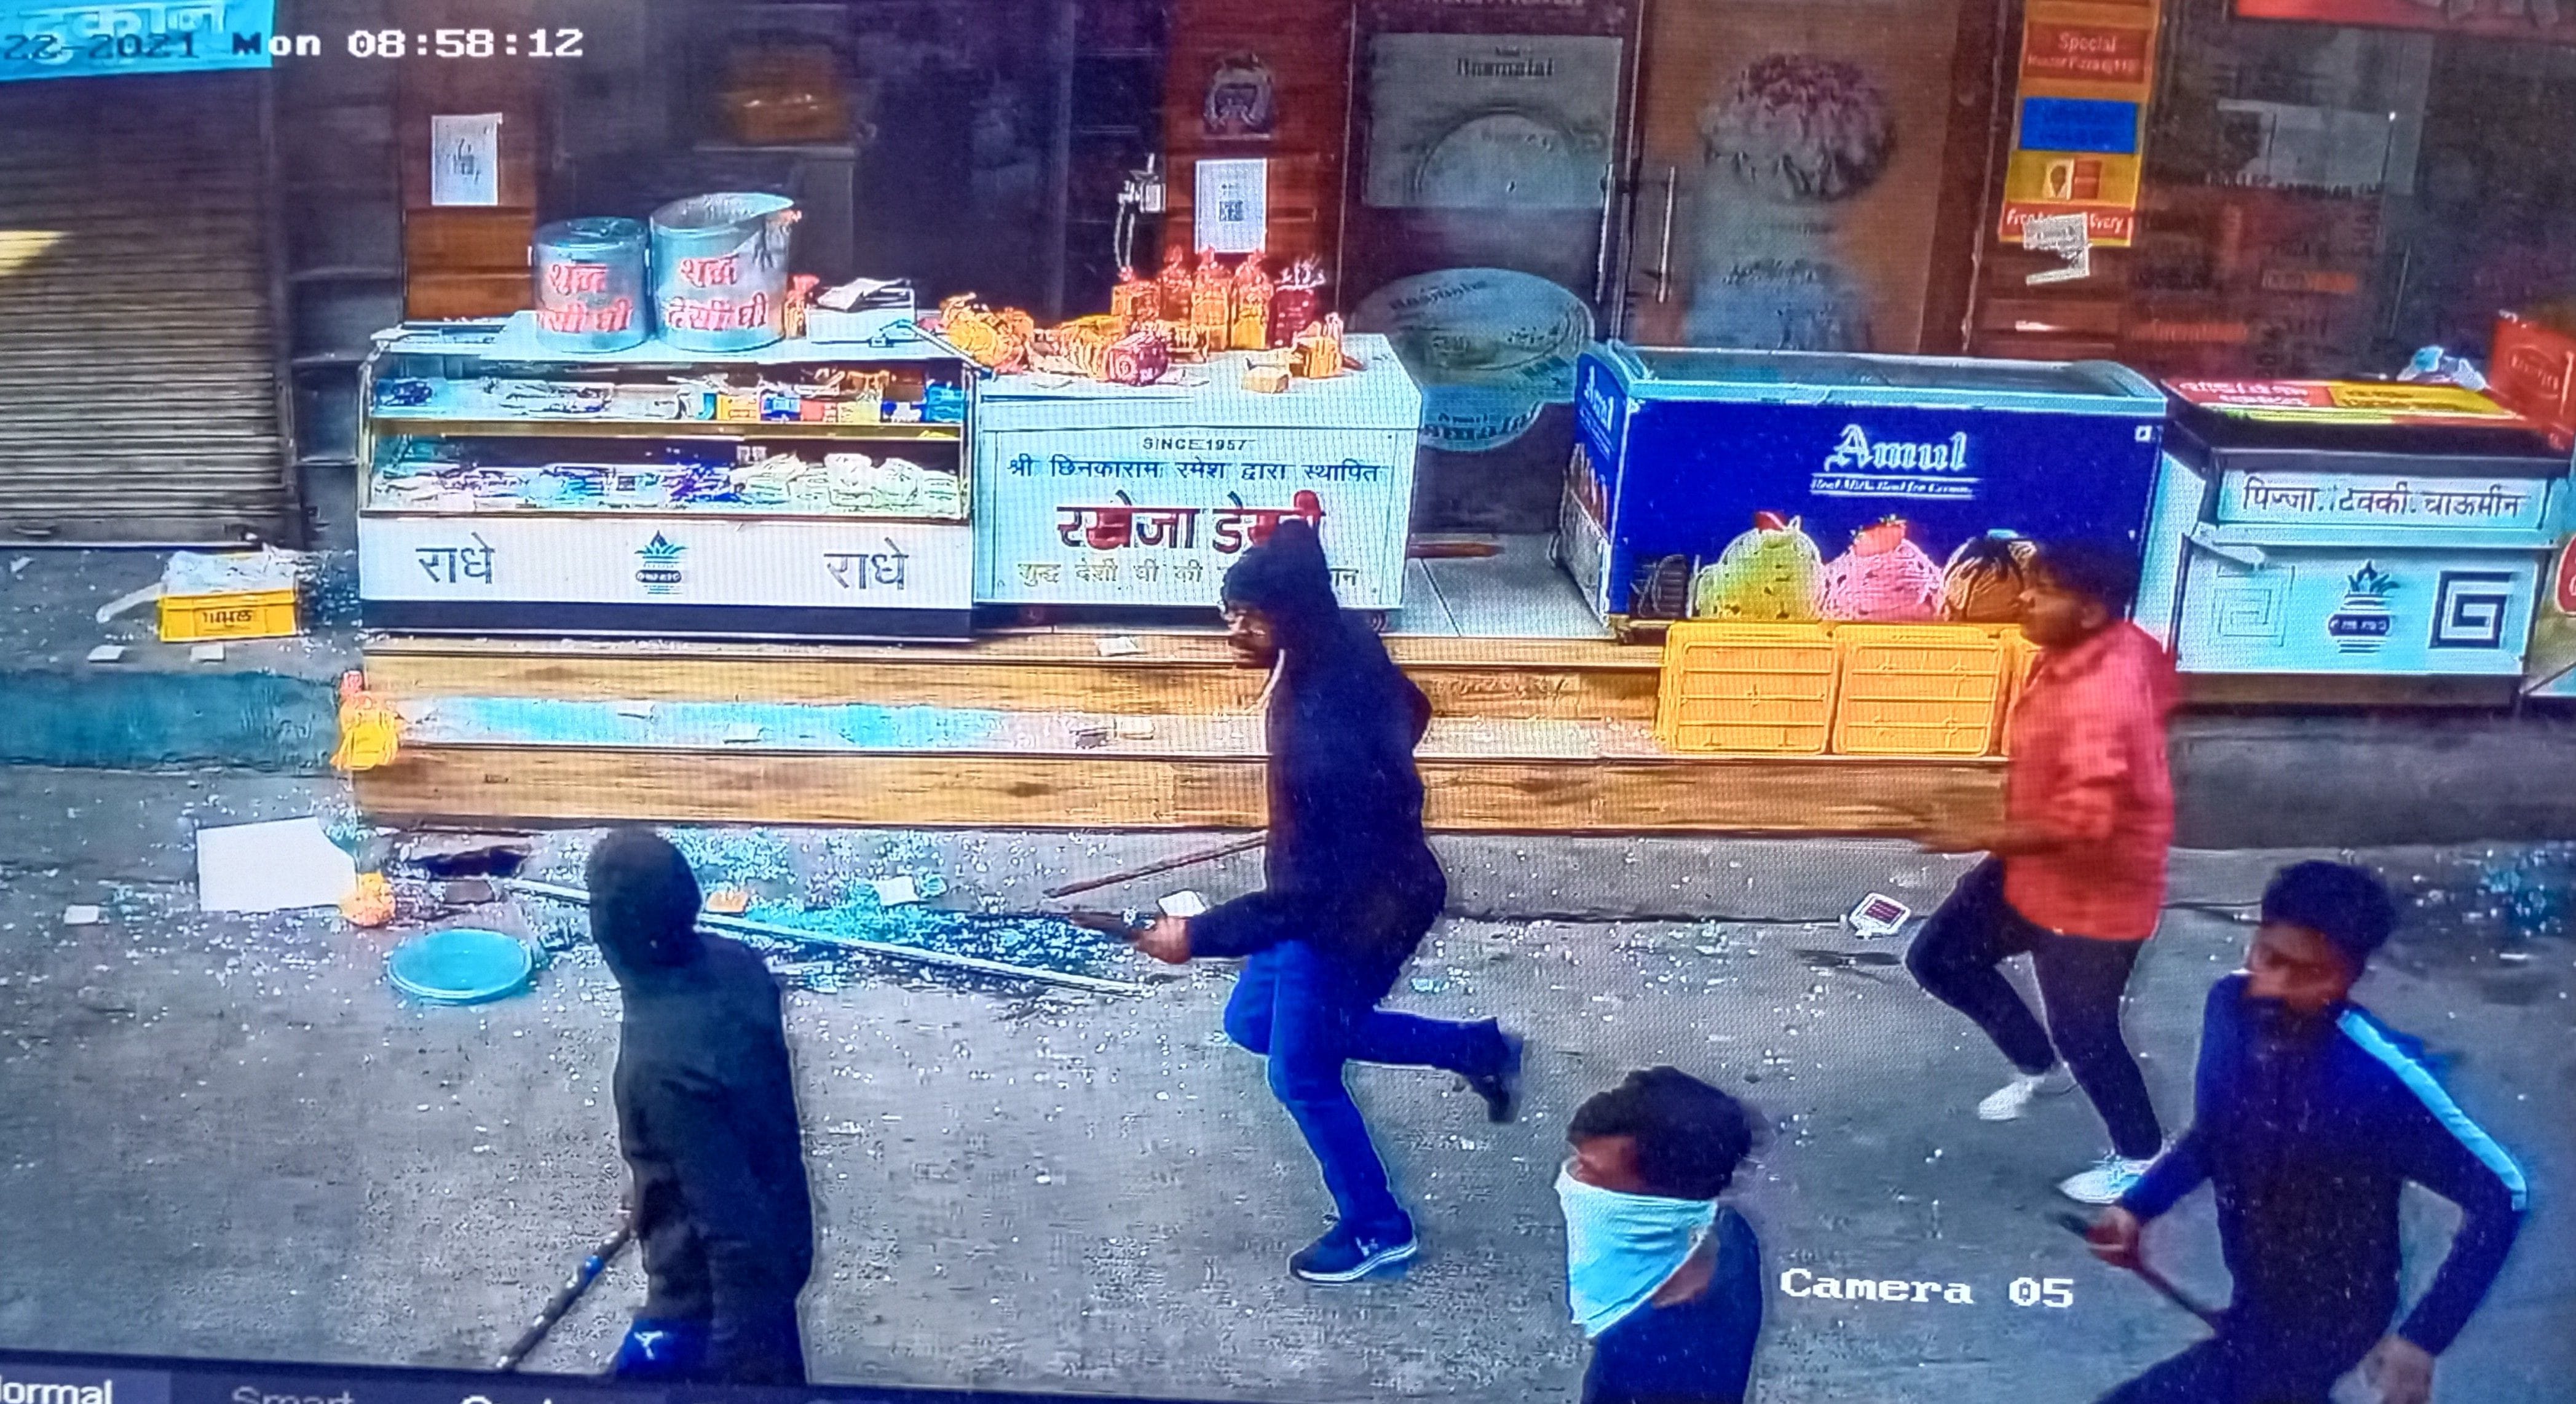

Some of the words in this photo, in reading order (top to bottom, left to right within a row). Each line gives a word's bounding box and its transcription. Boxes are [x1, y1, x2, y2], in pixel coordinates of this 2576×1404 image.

[2059, 33, 2117, 52] Special
[1142, 437, 1206, 450] SINCE
[1206, 438, 1248, 451] 1957
[1823, 423, 1967, 472] Amul
[1006, 453, 1035, 477] श्री
[1175, 456, 1230, 478] रमेश
[1241, 462, 1292, 480] द्वारा
[1300, 458, 1381, 482] स्थापित
[415, 531, 496, 584] राधे
[823, 537, 909, 590] राधे
[1133, 558, 1160, 582] घी
[1172, 559, 1203, 583] की
[0, 1376, 113, 1404] ormal
